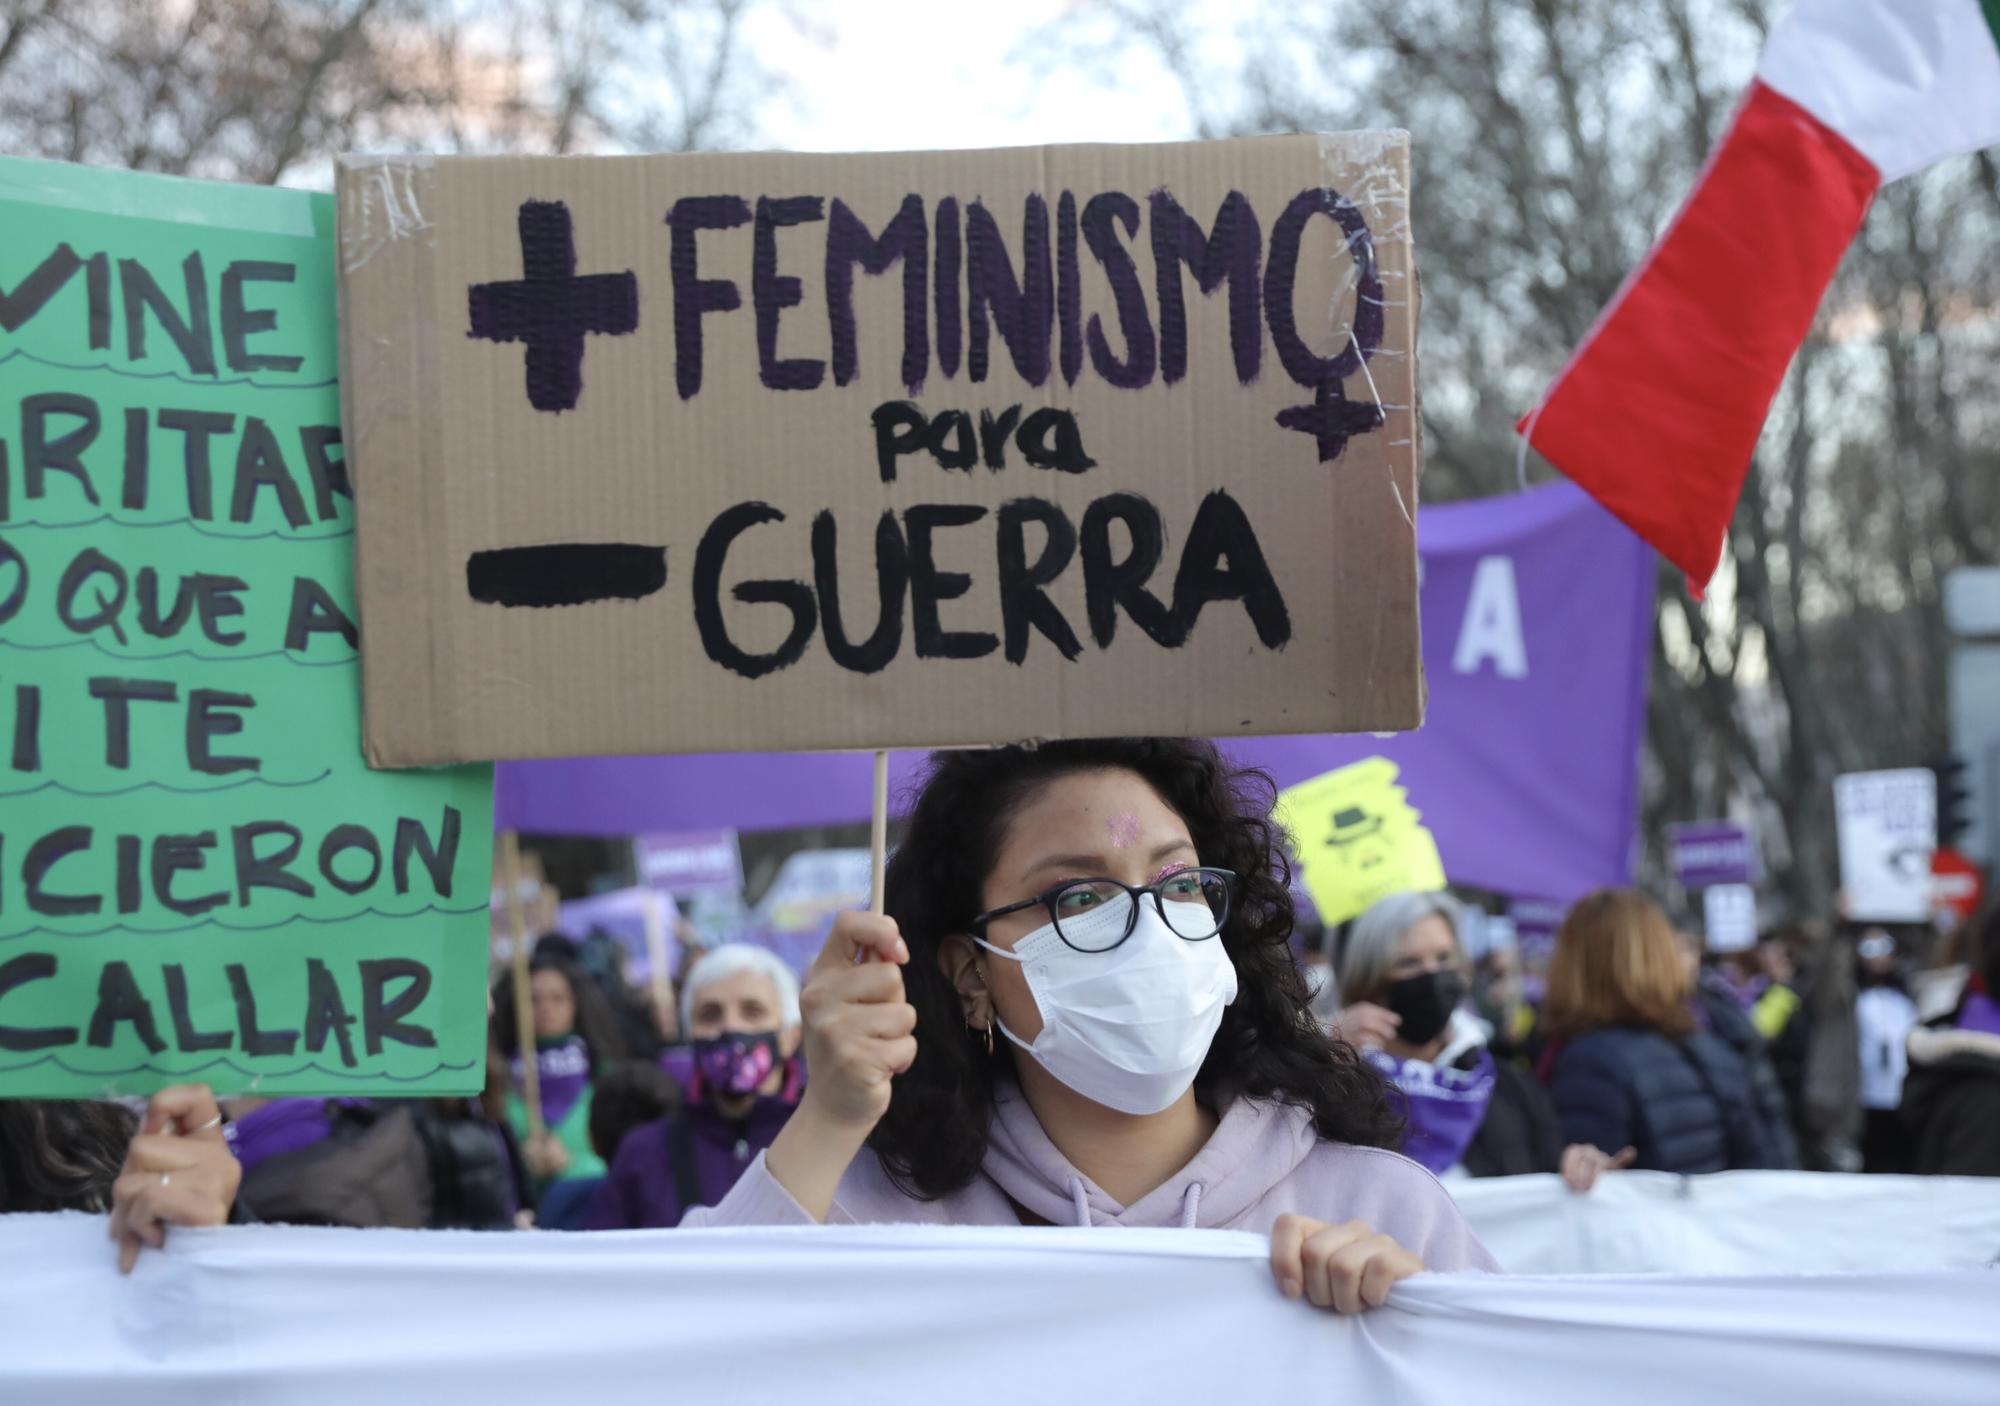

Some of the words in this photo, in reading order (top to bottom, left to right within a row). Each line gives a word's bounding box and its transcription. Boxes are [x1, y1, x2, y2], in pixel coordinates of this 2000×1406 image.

[664, 187, 1386, 401] FEMINISMO
[0, 392, 352, 530] RITAR
[872, 399, 1098, 483] para
[57, 547, 250, 646] QUE
[692, 487, 1293, 680] GUERRA
[0, 804, 462, 917] CIERON
[0, 952, 437, 1067] CALLAR
